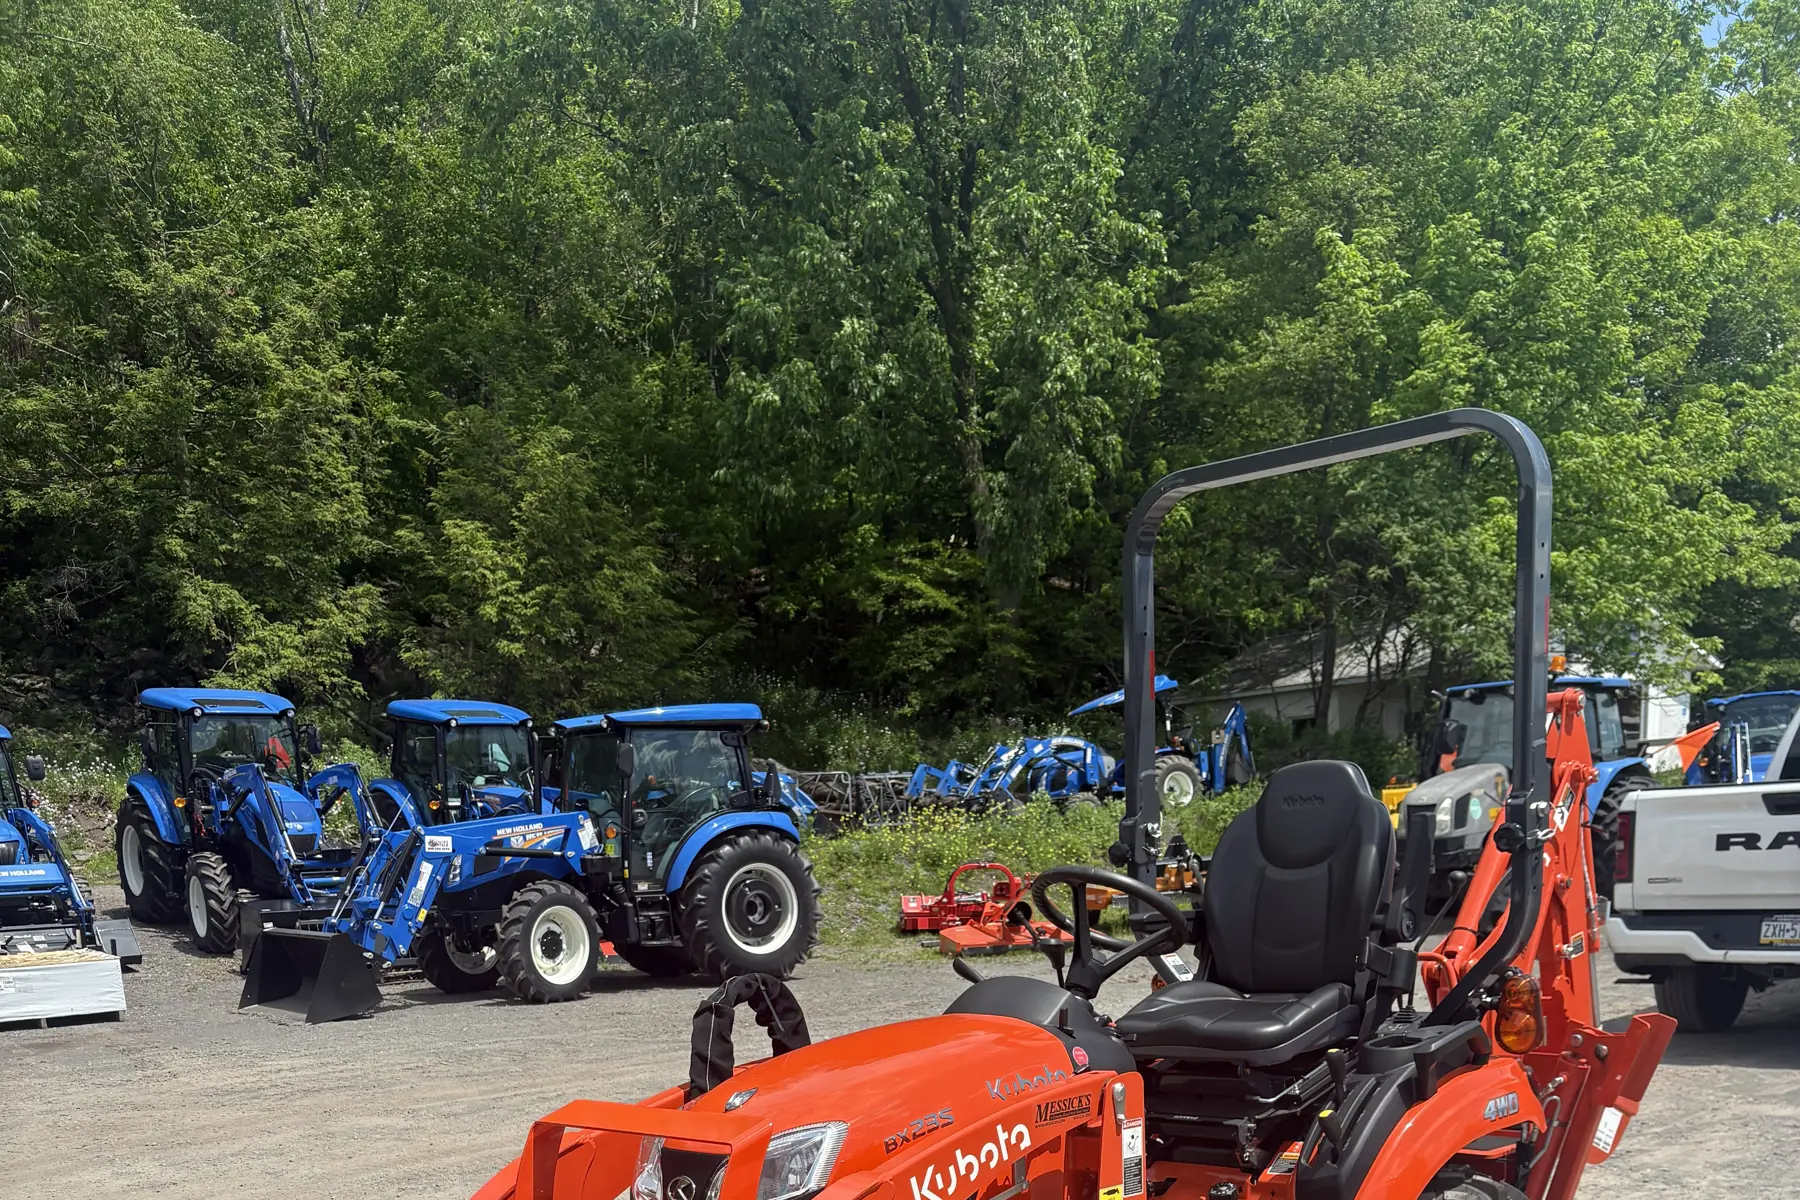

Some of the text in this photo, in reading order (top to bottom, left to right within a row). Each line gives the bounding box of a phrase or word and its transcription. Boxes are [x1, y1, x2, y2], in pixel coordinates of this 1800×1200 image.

[496, 828, 513, 836] NEW
[513, 822, 543, 833] HOLLAND
[986, 1065, 1067, 1101] Kubota
[1035, 1093, 1092, 1124] MESSICK'S
[1483, 1091, 1519, 1122] 4WD
[883, 1106, 955, 1155] BX23S
